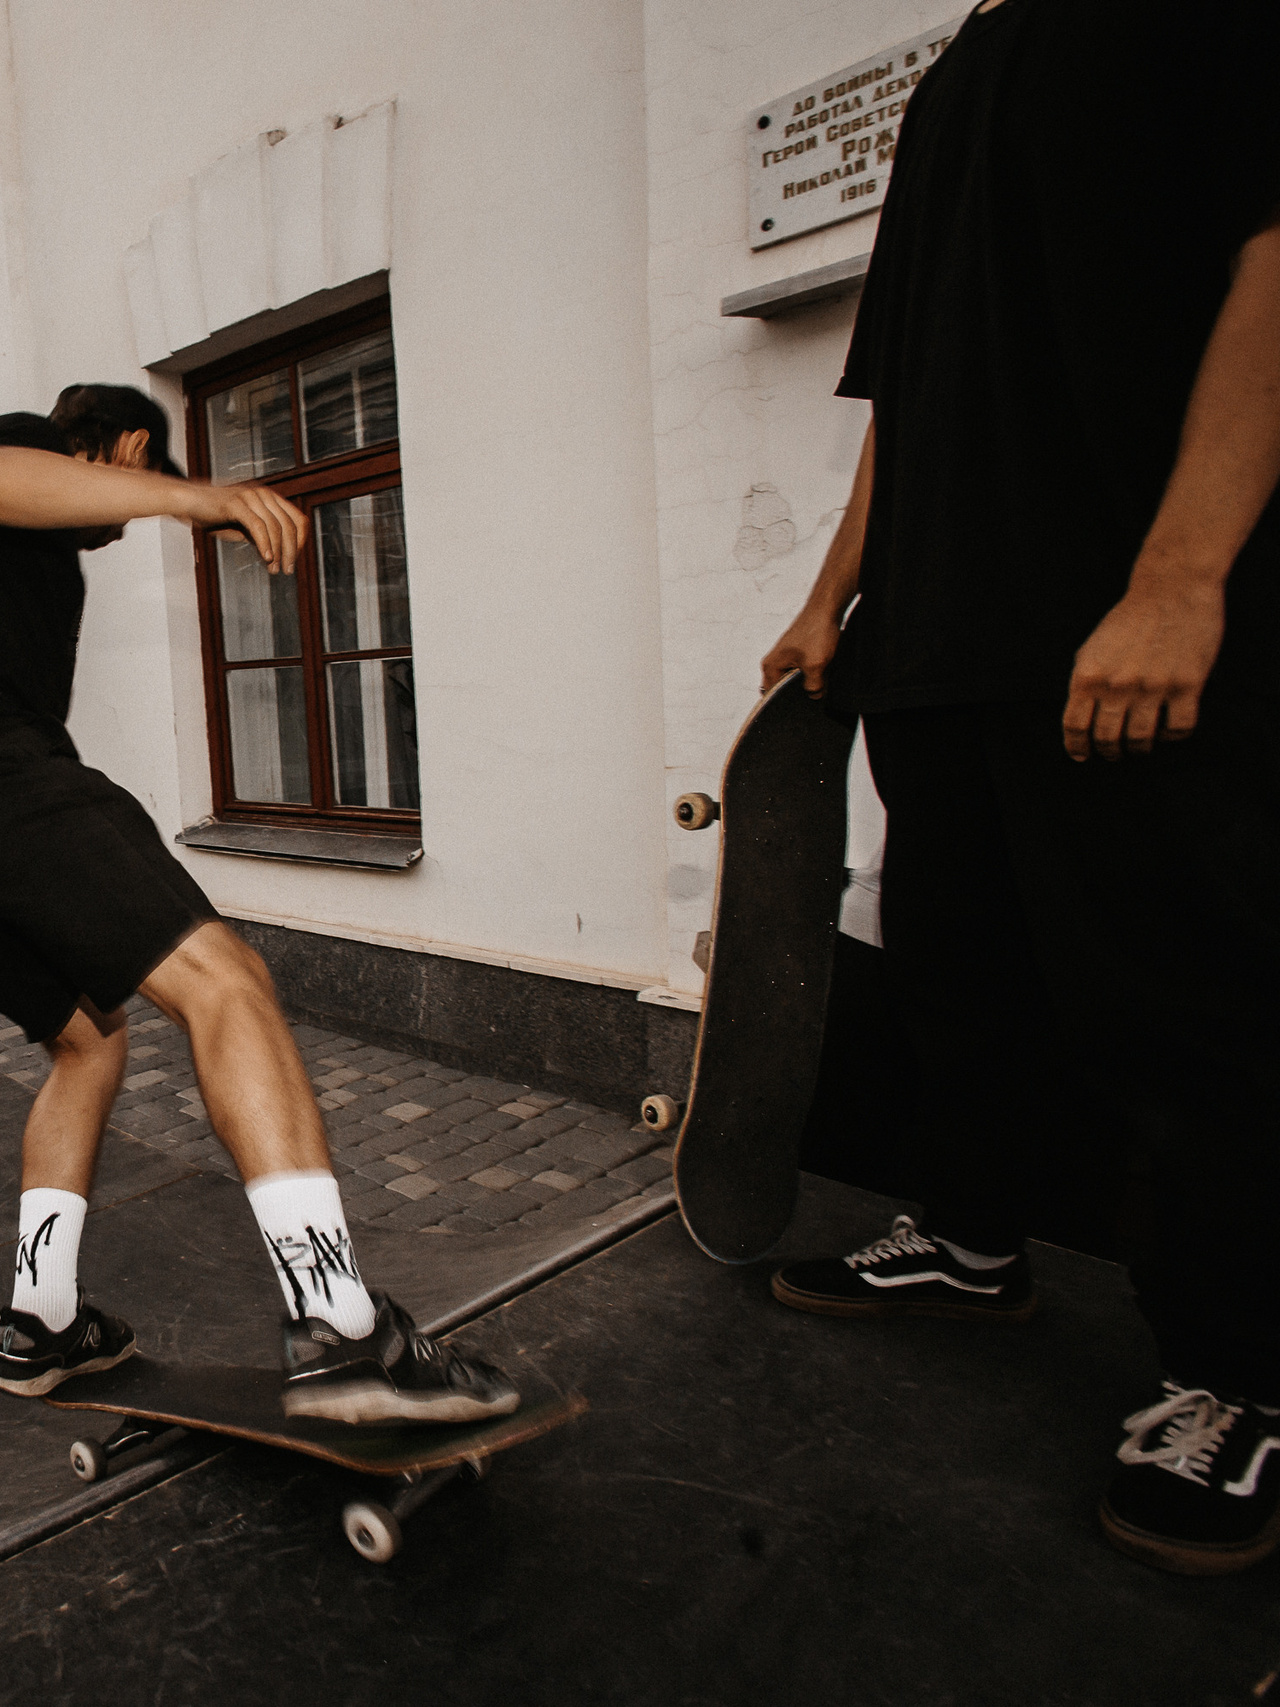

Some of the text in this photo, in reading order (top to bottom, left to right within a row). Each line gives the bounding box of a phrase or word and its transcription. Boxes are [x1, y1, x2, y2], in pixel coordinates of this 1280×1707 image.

[784, 66, 932, 138] РАБОТАЛ ДЕКО
[792, 96, 816, 116] ДО
[823, 61, 893, 103] ВОЙНЫ
[904, 51, 918, 68] В
[842, 126, 900, 161] РОЖ
[840, 178, 876, 203] 1916
